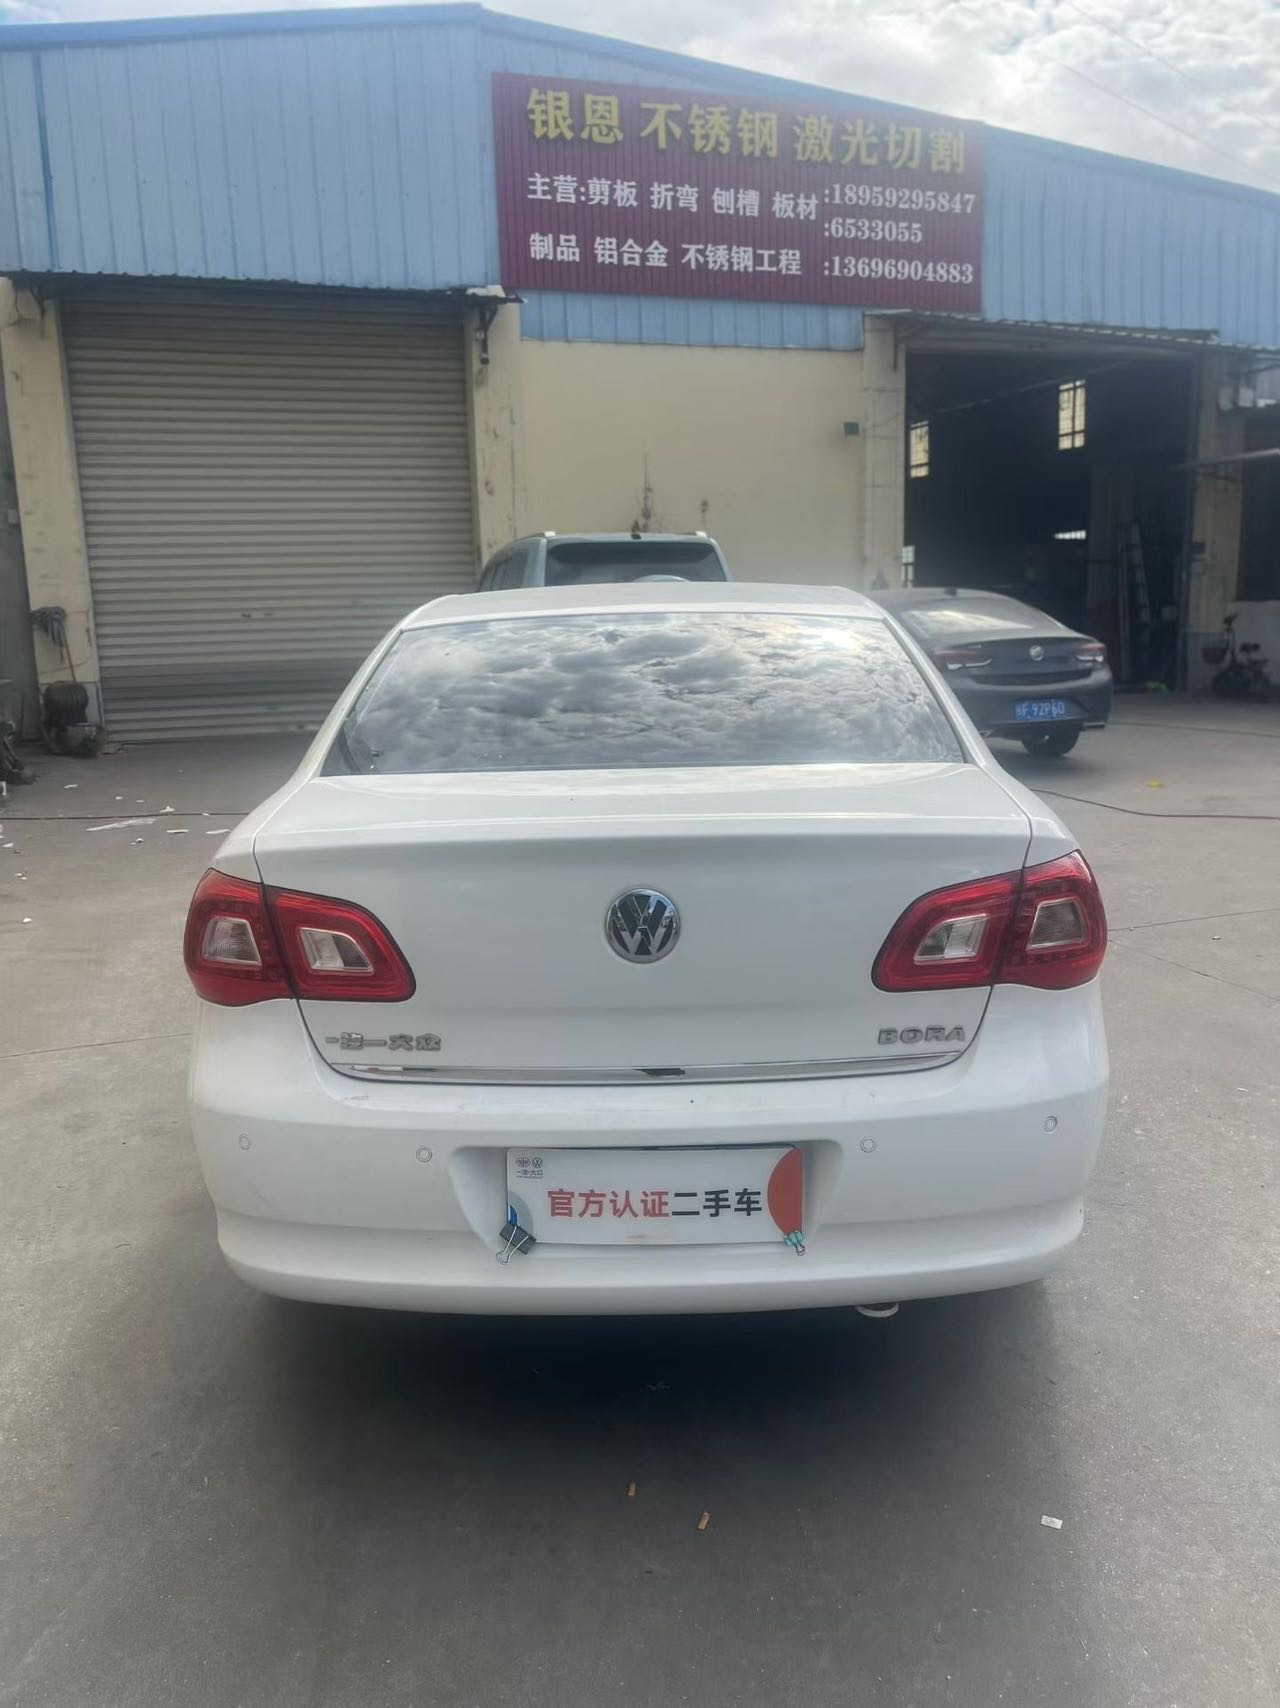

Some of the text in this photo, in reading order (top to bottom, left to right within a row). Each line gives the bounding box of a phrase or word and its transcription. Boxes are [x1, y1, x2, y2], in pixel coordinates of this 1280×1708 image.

[527, 88, 966, 174] 银恩 不锈钢 激光切割
[649, 181, 699, 213] 折弯
[712, 187, 760, 217] 刨槽
[772, 191, 819, 221] 板材
[529, 232, 802, 276] 制品 铝合金 不锈钢工程
[878, 1025, 966, 1045] BORA
[547, 1187, 763, 1219] 官方认证二手车
